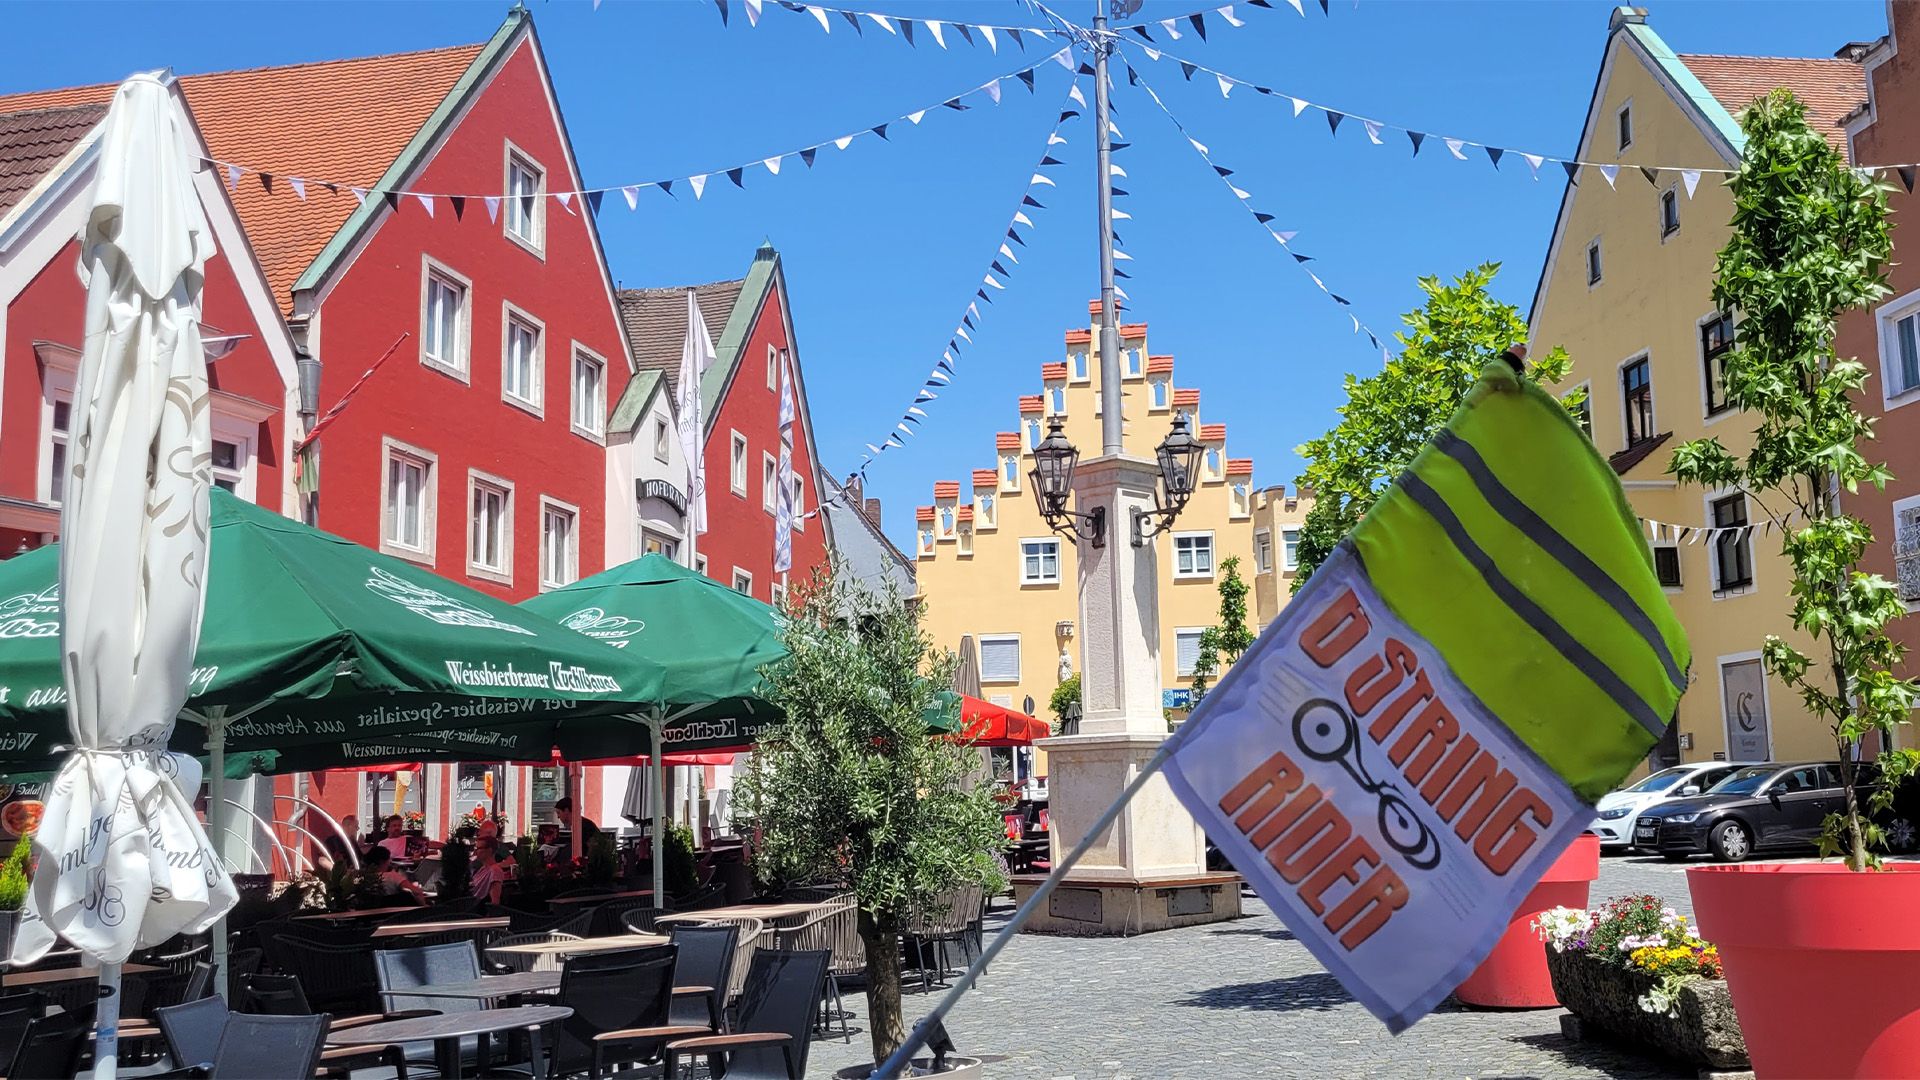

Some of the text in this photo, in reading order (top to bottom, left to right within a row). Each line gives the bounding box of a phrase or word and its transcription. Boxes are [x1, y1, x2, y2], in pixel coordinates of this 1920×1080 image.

[445, 661, 622, 692] Weissbierbrauer Kuchlbauer
[1174, 691, 1189, 699] IHK
[1300, 588, 1554, 876] D STRING
[1218, 751, 1410, 952] RIDER
